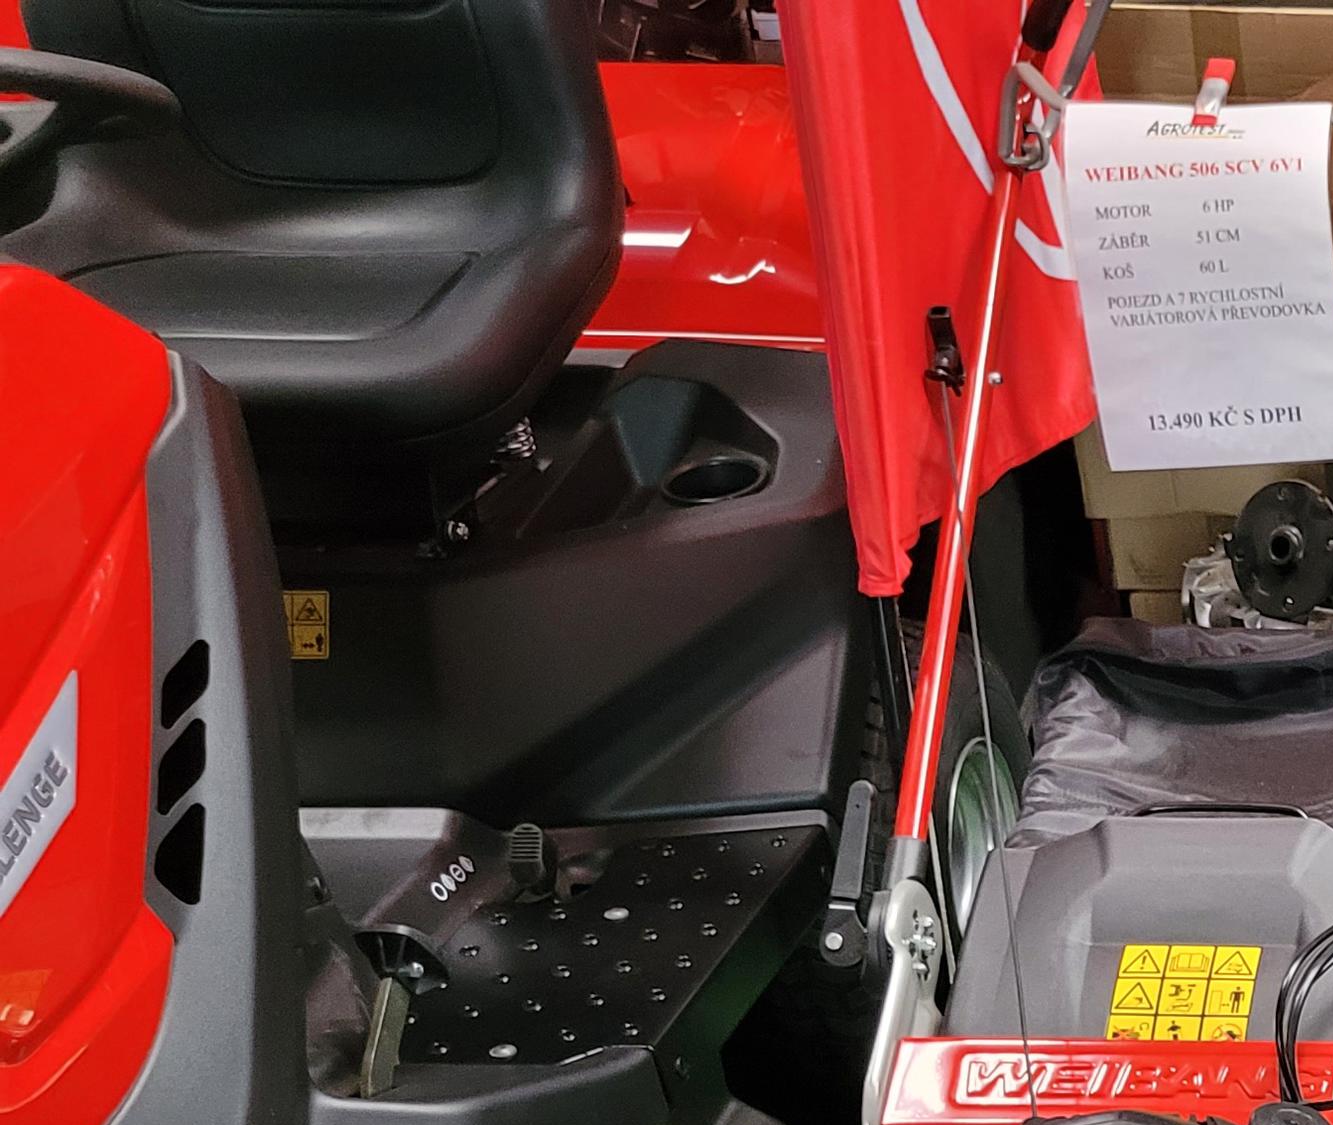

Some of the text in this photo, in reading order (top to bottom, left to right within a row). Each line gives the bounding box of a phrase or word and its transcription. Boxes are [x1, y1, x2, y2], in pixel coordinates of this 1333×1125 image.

[1086, 158, 1303, 183] WEIBANG 506 SCV 6V1
[1096, 200, 1235, 220] MOTOR 6 HP
[1099, 229, 1241, 251] ZÁBĚR 51 CM
[1103, 261, 1229, 281] KOŠ 60 L
[1108, 285, 1284, 309] POJEZD A 7 RYCHLOSTNÍ
[1110, 302, 1326, 328] VARIÁTOROVÁ PŘEVODOVKA
[1149, 406, 1302, 431] 13.490 KČ S DPH
[967, 1058, 1331, 1100] WEIBANG
